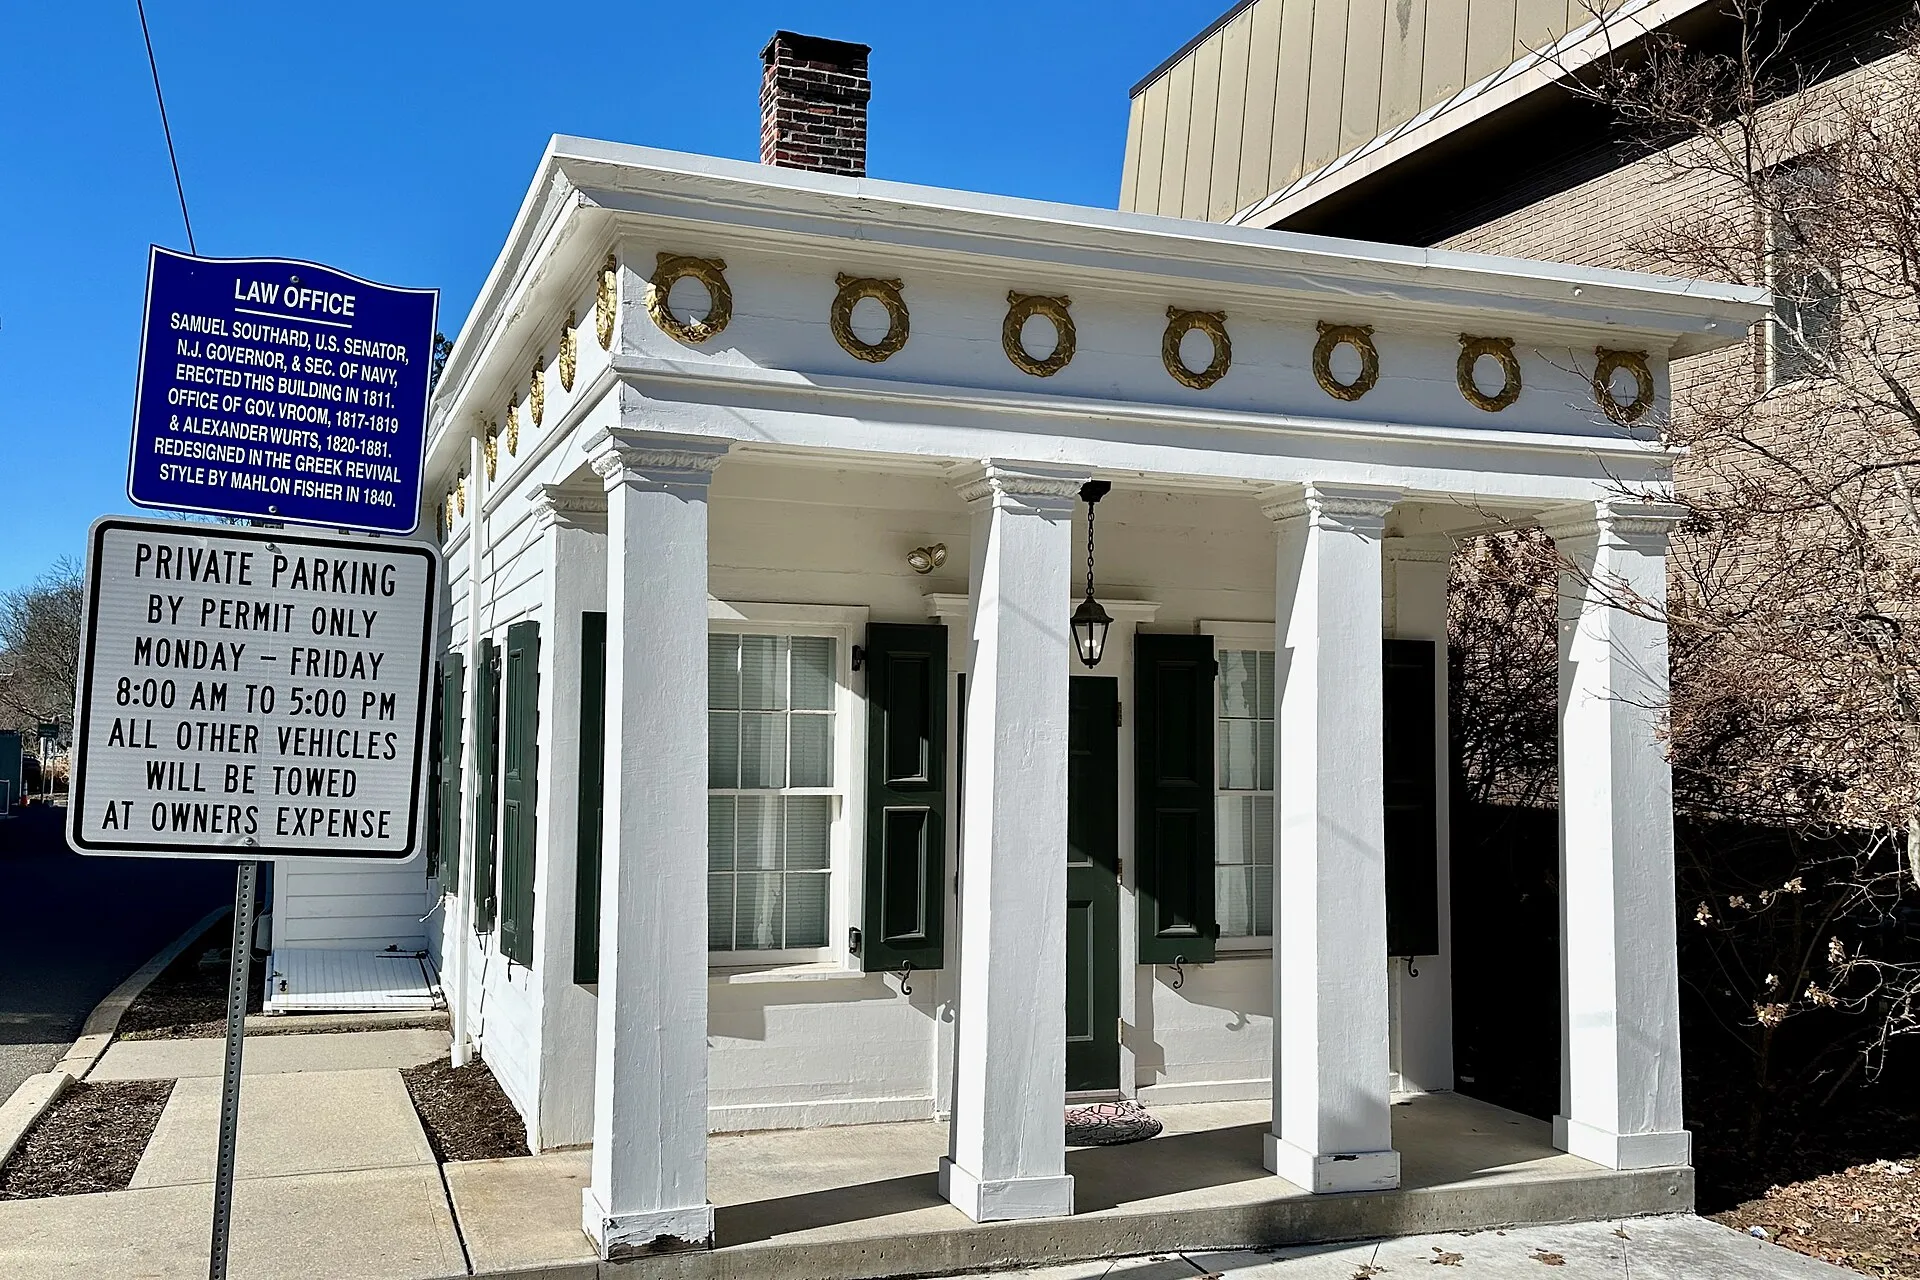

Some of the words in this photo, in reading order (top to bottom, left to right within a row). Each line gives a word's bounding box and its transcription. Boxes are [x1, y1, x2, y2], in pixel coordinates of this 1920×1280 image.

[235, 279, 279, 304] LAW
[284, 286, 355, 316] OFFICE
[171, 312, 228, 336] SAMUEL
[232, 321, 311, 351] SOUTHARD,
[316, 333, 340, 352] U.S.
[344, 338, 408, 365] SENATOR,
[176, 363, 241, 387] ERECTED
[244, 372, 274, 392] THIS
[278, 377, 342, 401] BUILDING
[345, 386, 359, 403] IN
[363, 389, 394, 408] 1811.
[177, 339, 201, 358] N.J.
[206, 343, 287, 373] GOVERNOR,
[292, 355, 301, 372] &
[305, 357, 335, 376] SEC.
[340, 362, 358, 379] OF
[361, 365, 397, 388] NAVY,
[168, 388, 219, 410] OFFICE
[222, 395, 242, 412] OF
[245, 398, 275, 417] GOV.
[279, 402, 331, 428] VROOM,
[336, 411, 398, 434] 1817-1819
[169, 414, 179, 431] &
[183, 416, 268, 442] ALEXANDER
[270, 427, 321, 452] WURTS,
[327, 435, 391, 458] 1820-1881.
[154, 437, 245, 463] REDESIGNED
[248, 449, 263, 466] IN
[265, 451, 291, 469] THE
[295, 455, 343, 476] GREEK
[346, 461, 401, 483] REVIVAL
[160, 463, 204, 484] STYLE
[208, 469, 228, 487] BY
[231, 472, 290, 494] MAHLON
[294, 479, 342, 501] FISHER
[346, 486, 359, 502] IN
[364, 488, 395, 507] 1840.
[135, 543, 253, 586] PRIVATE
[272, 555, 396, 597] PARKING
[147, 594, 184, 625] BY
[201, 598, 295, 633] PERMIT
[312, 607, 378, 639] ONLY
[134, 636, 246, 672] MONDAY
[290, 647, 384, 680] FRIDAY
[116, 677, 176, 709] 8:00
[189, 681, 227, 712] AM
[245, 684, 275, 714] TO
[289, 687, 346, 718] 5:00
[361, 691, 396, 721] PM
[108, 718, 157, 749] ALL
[177, 721, 259, 754] OTHER
[278, 726, 397, 760] VEHICLES
[146, 761, 206, 792] WILL
[224, 764, 256, 794] BE
[273, 766, 356, 798] TOWED
[102, 800, 134, 830] AT
[152, 802, 258, 834] OWNERS
[276, 807, 391, 839] EXPENSE
